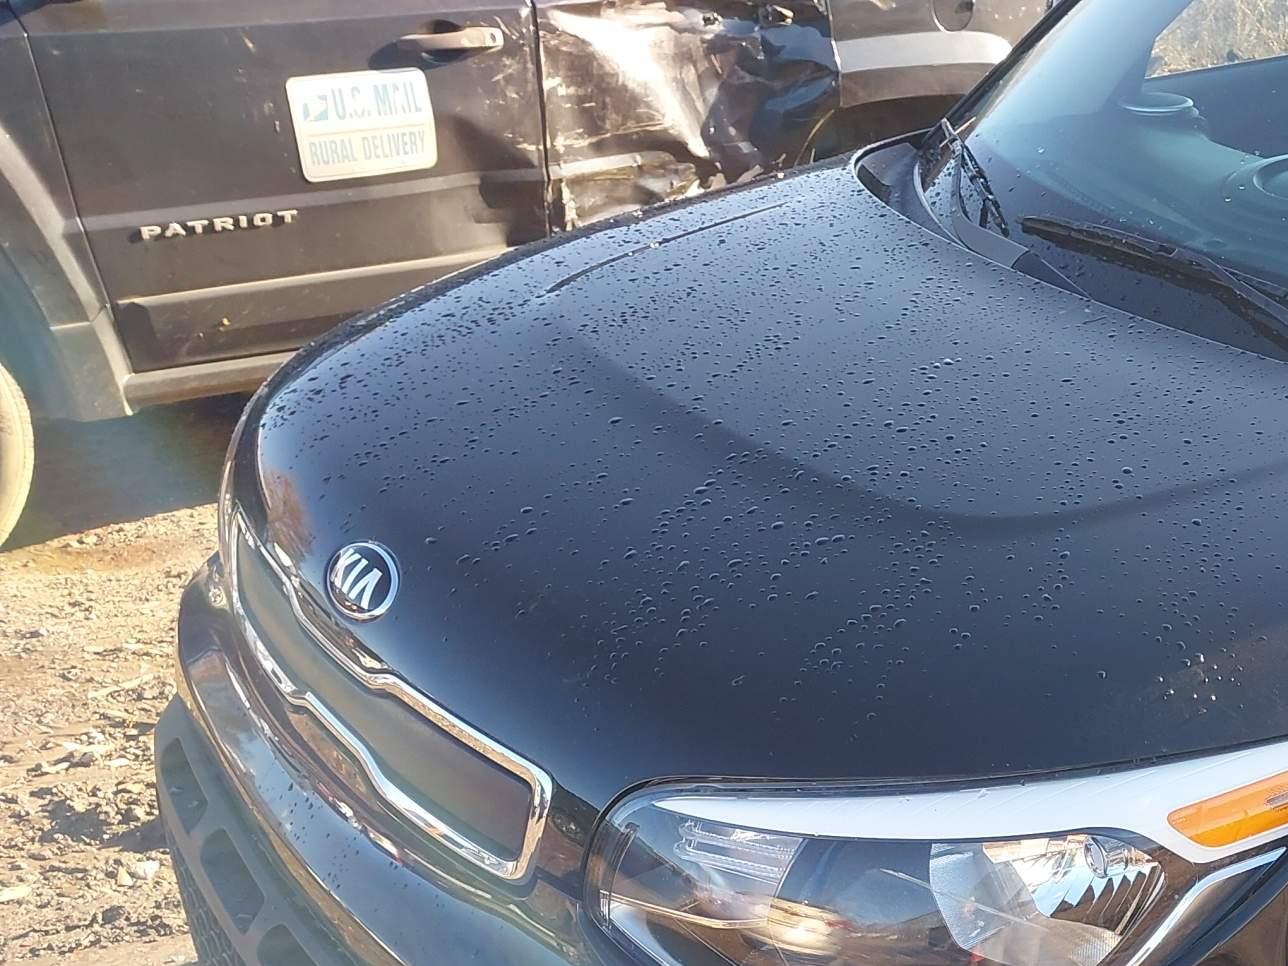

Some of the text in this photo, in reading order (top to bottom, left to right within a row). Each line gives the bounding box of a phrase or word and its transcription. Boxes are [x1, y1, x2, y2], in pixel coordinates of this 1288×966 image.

[308, 130, 426, 167] RURAL DELIVERY
[139, 209, 299, 241] PATRIOT
[330, 547, 384, 610] KIA
